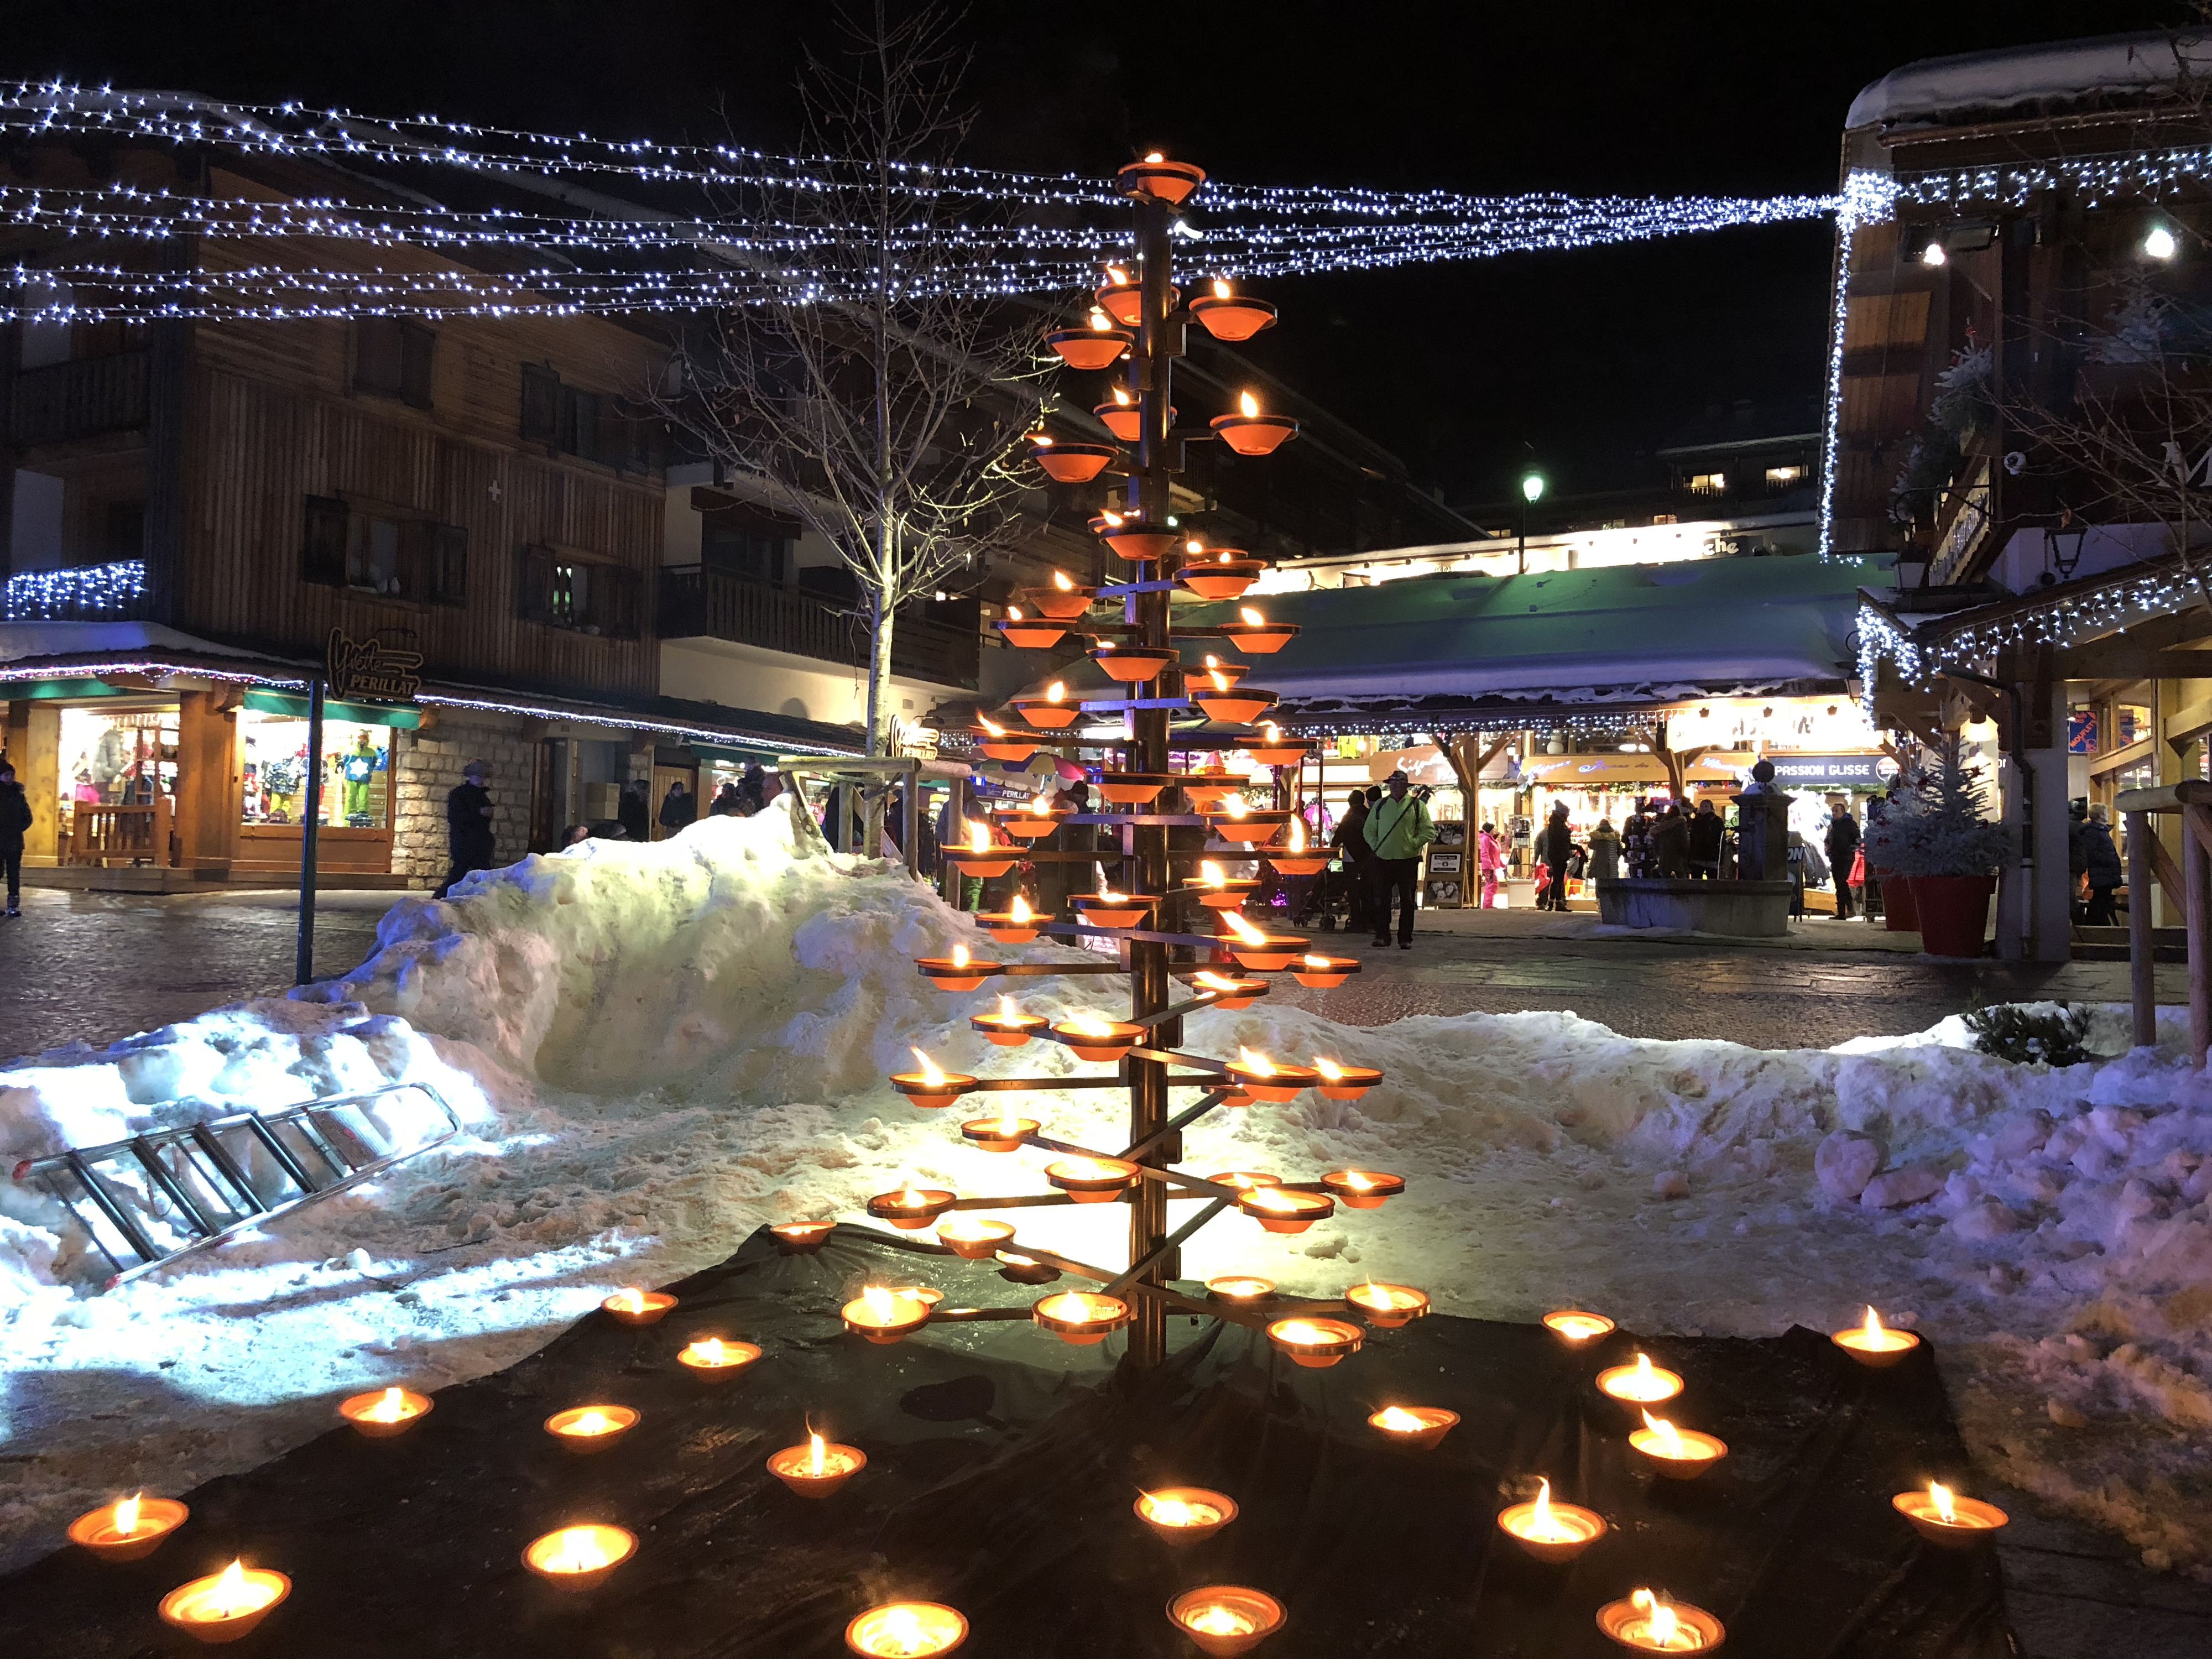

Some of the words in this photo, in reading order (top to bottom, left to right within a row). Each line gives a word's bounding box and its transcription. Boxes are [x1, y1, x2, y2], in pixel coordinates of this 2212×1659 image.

[350, 674, 416, 695] PERILLAT
[1775, 765, 1825, 776] PASSION
[1829, 765, 1870, 775] GLISSE
[1002, 790, 1030, 800] PERILLAT
